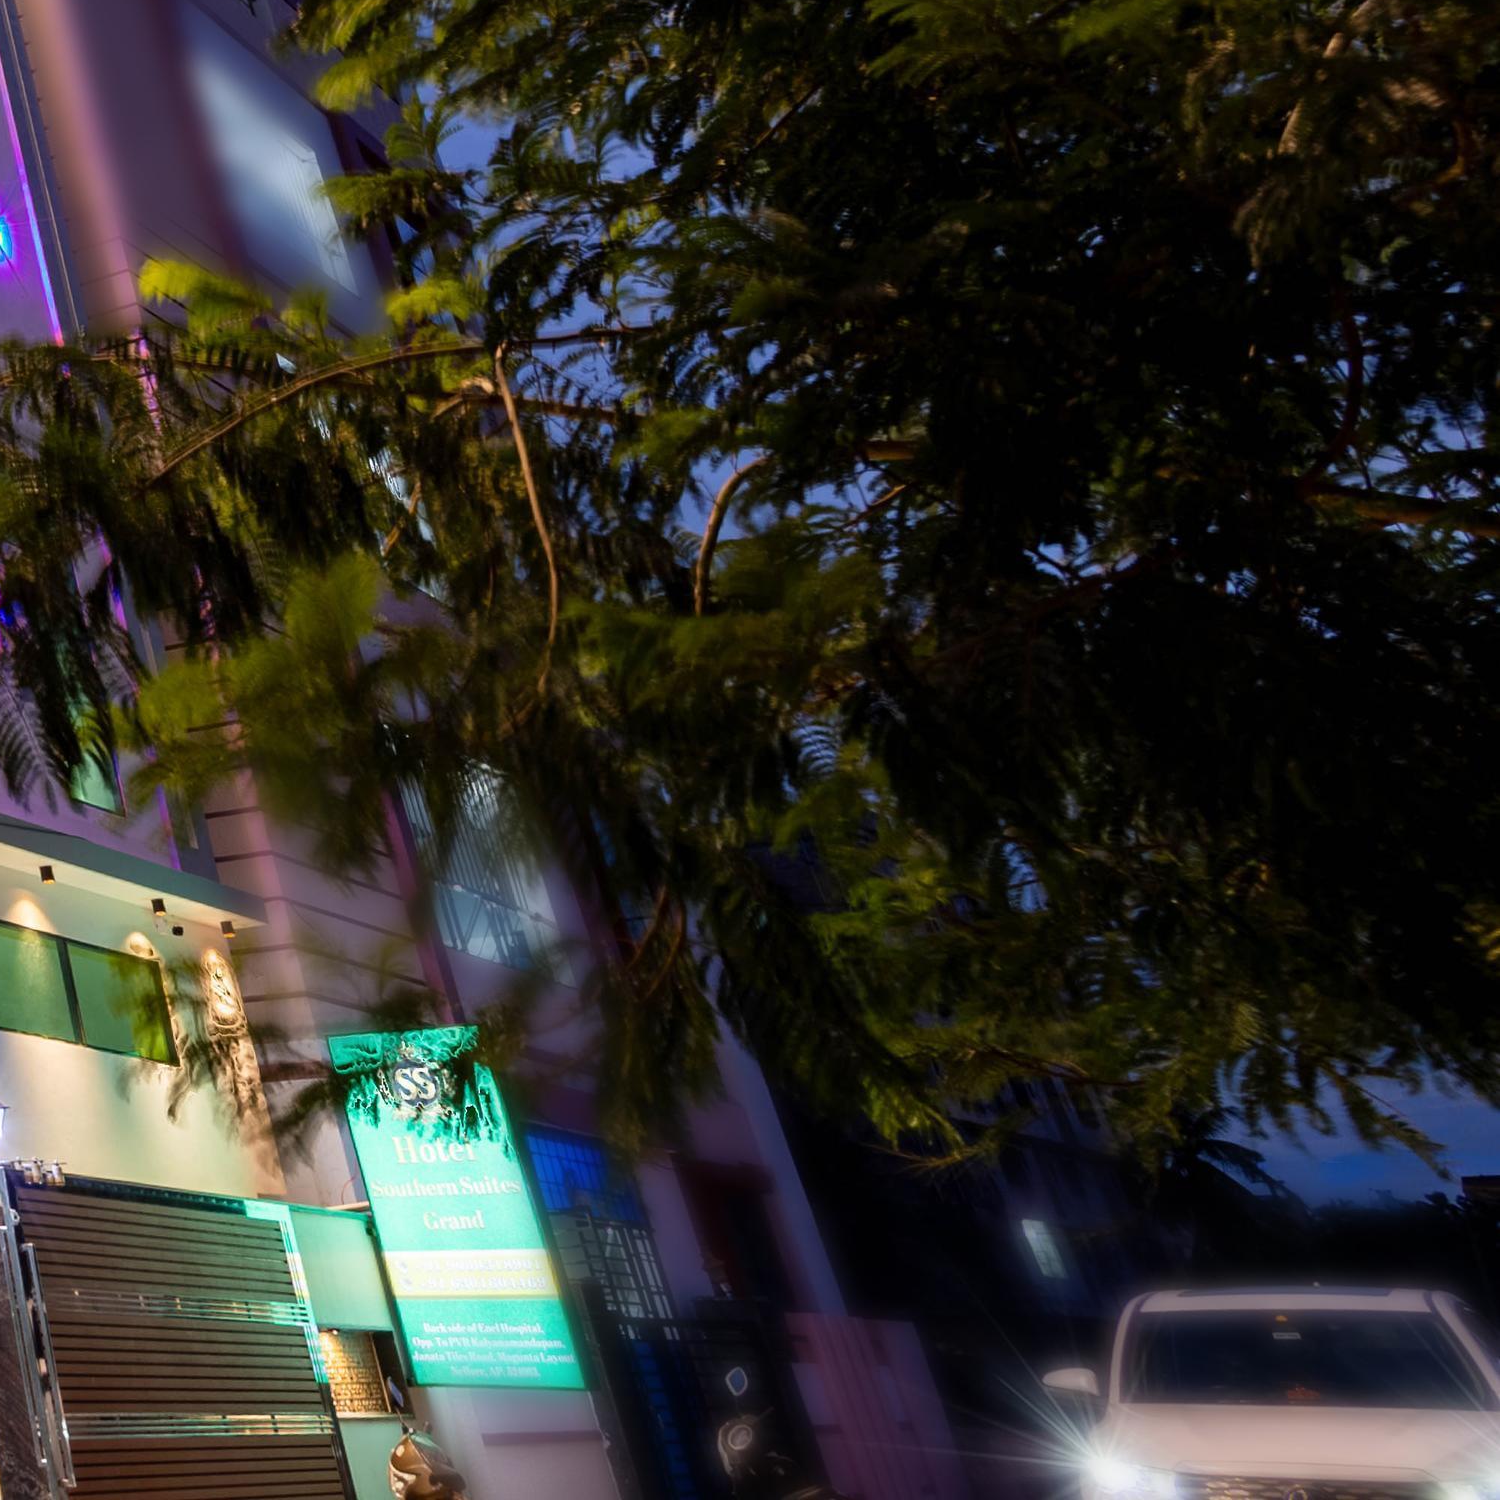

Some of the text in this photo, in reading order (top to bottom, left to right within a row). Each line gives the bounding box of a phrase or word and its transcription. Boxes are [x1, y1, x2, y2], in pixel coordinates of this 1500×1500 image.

[394, 1066, 437, 1101] SS
[392, 1135, 479, 1164] Hotel
[370, 1173, 522, 1198] Southern Suites
[423, 1209, 486, 1231] Grand
